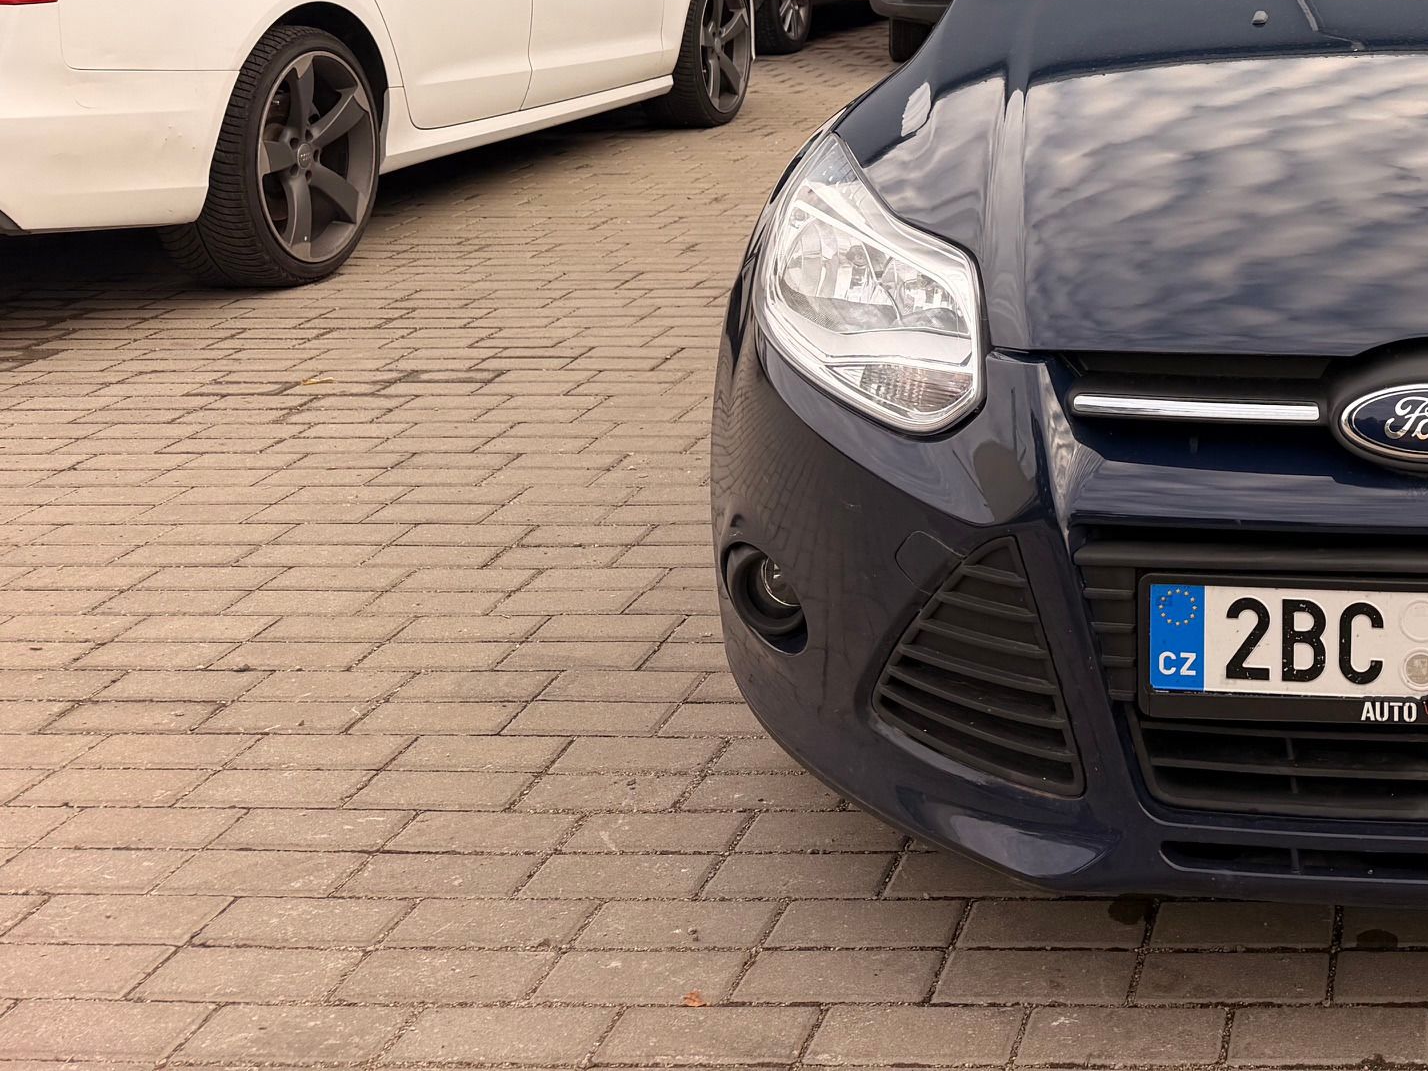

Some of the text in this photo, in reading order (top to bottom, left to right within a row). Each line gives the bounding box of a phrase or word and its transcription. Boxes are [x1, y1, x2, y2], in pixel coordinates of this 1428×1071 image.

[1226, 596, 1384, 684] 2BC
[1158, 651, 1197, 676] CZ
[1360, 701, 1417, 723] AUTO
